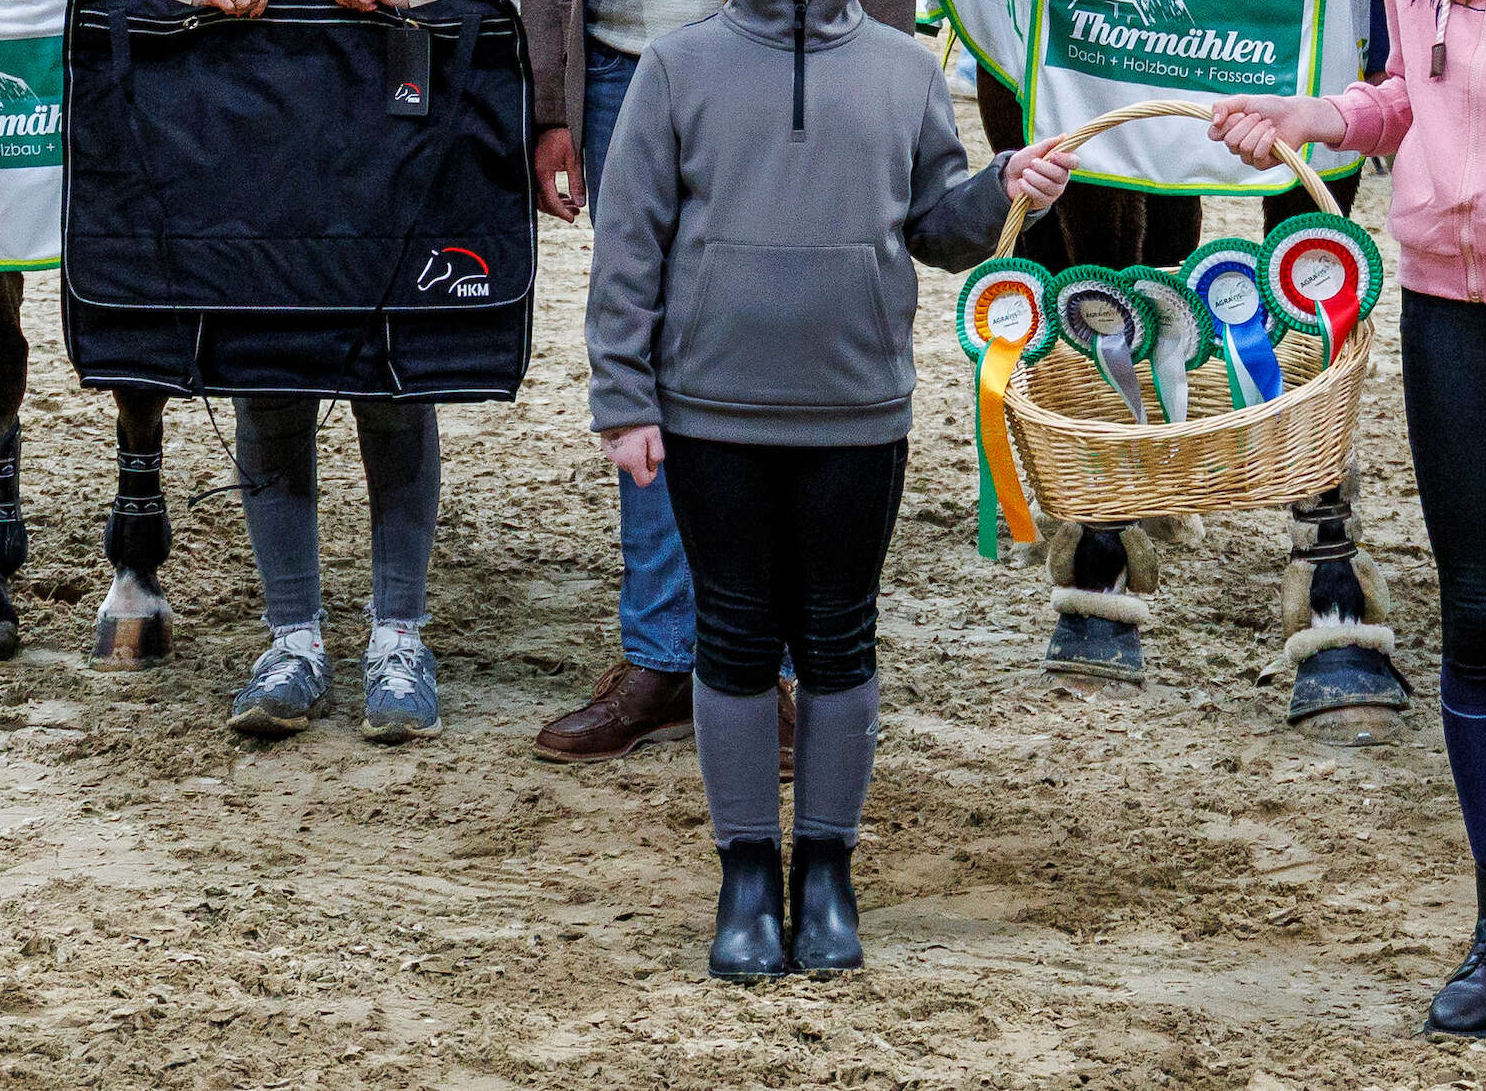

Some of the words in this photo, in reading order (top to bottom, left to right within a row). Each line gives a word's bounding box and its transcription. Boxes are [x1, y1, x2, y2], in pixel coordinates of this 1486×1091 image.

[1069, 9, 1277, 65] Thormählen
[1068, 44, 1107, 62] Dach
[1123, 56, 1190, 79] Holzbau
[1208, 66, 1277, 87] Fassade
[456, 283, 489, 297] HKM
